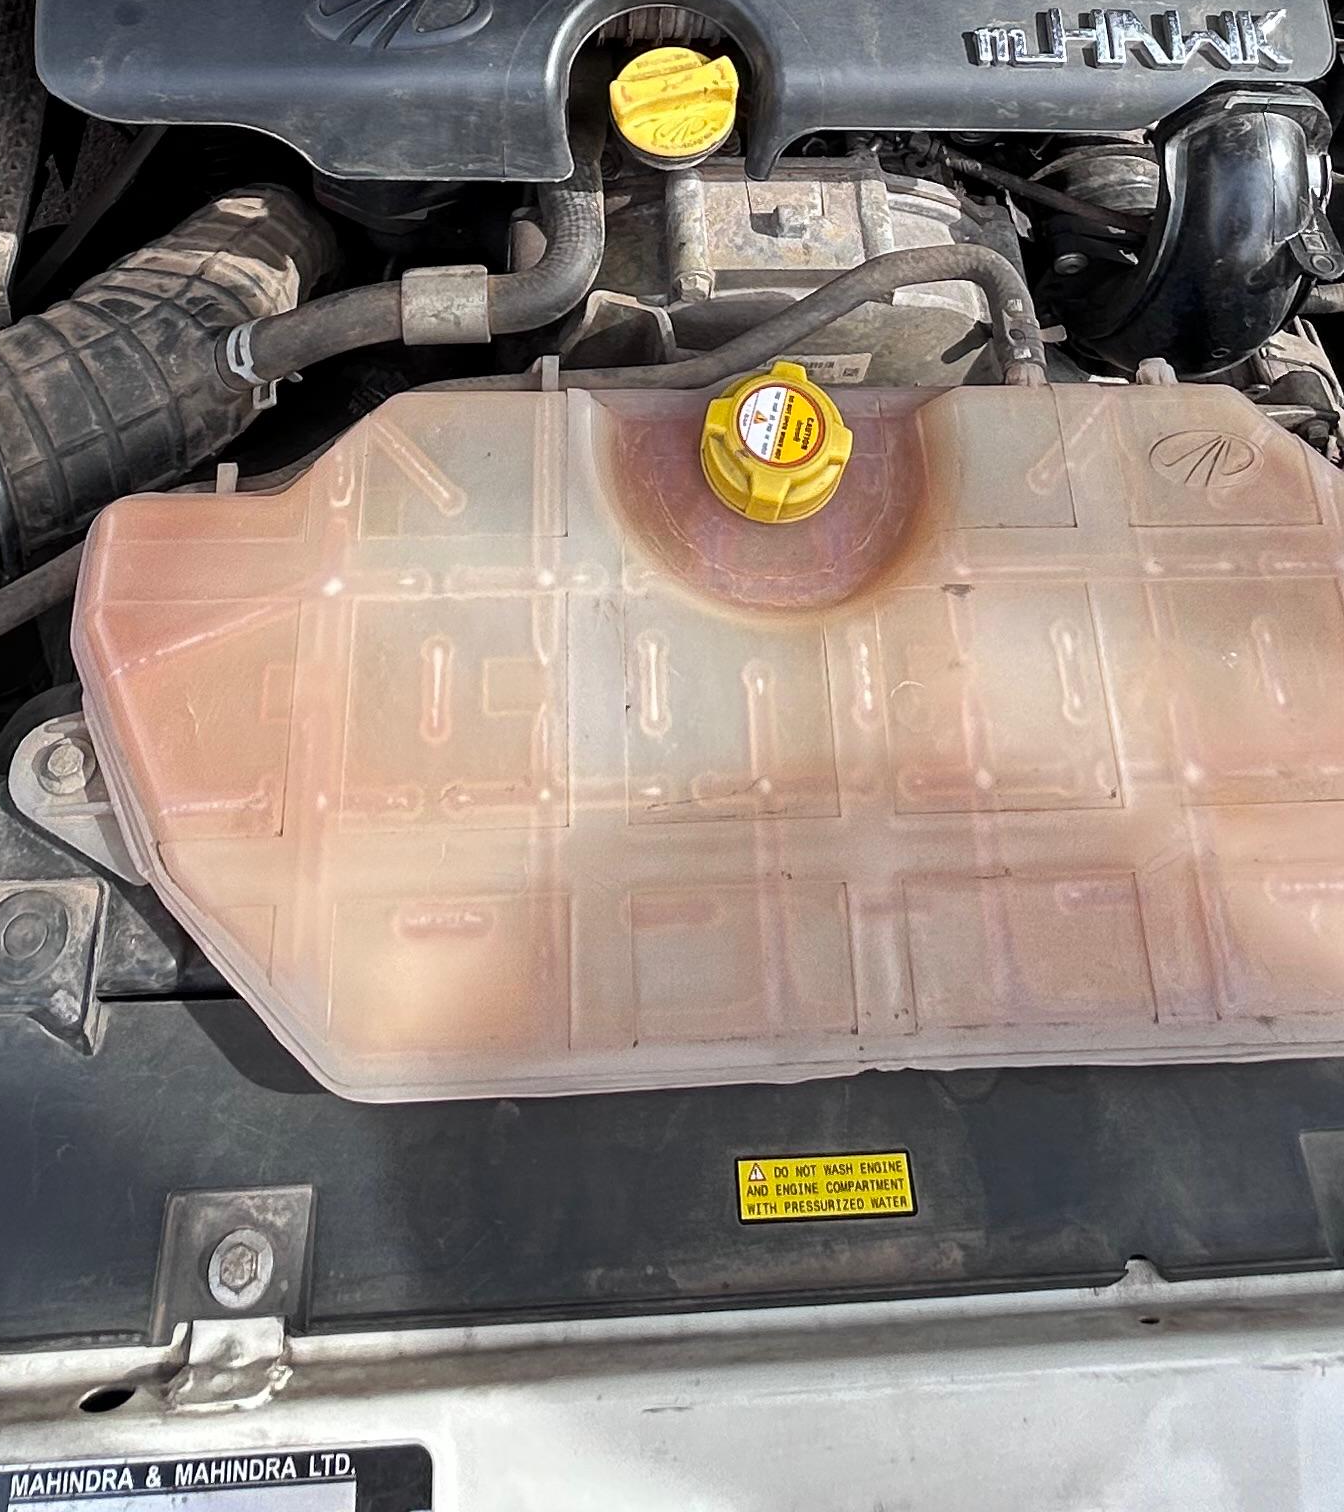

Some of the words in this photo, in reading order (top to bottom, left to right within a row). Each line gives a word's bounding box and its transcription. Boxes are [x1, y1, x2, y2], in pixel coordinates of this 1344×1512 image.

[774, 1166, 788, 1178] DO
[796, 1165, 816, 1176] NOT
[824, 1163, 853, 1175] WASH
[860, 1160, 902, 1174] ENGINE
[747, 1186, 768, 1197] AND
[776, 1183, 818, 1196] ENGINE
[826, 1178, 905, 1194] COMPARTMENT
[747, 1202, 777, 1215] WITH
[784, 1198, 864, 1213] PRESSURIZED
[871, 1195, 907, 1209] WATER
[10, 1466, 134, 1498] MAHINDRA
[145, 1465, 161, 1488] &
[174, 1456, 297, 1486] MAHINDRA
[309, 1452, 356, 1476] LTD.
